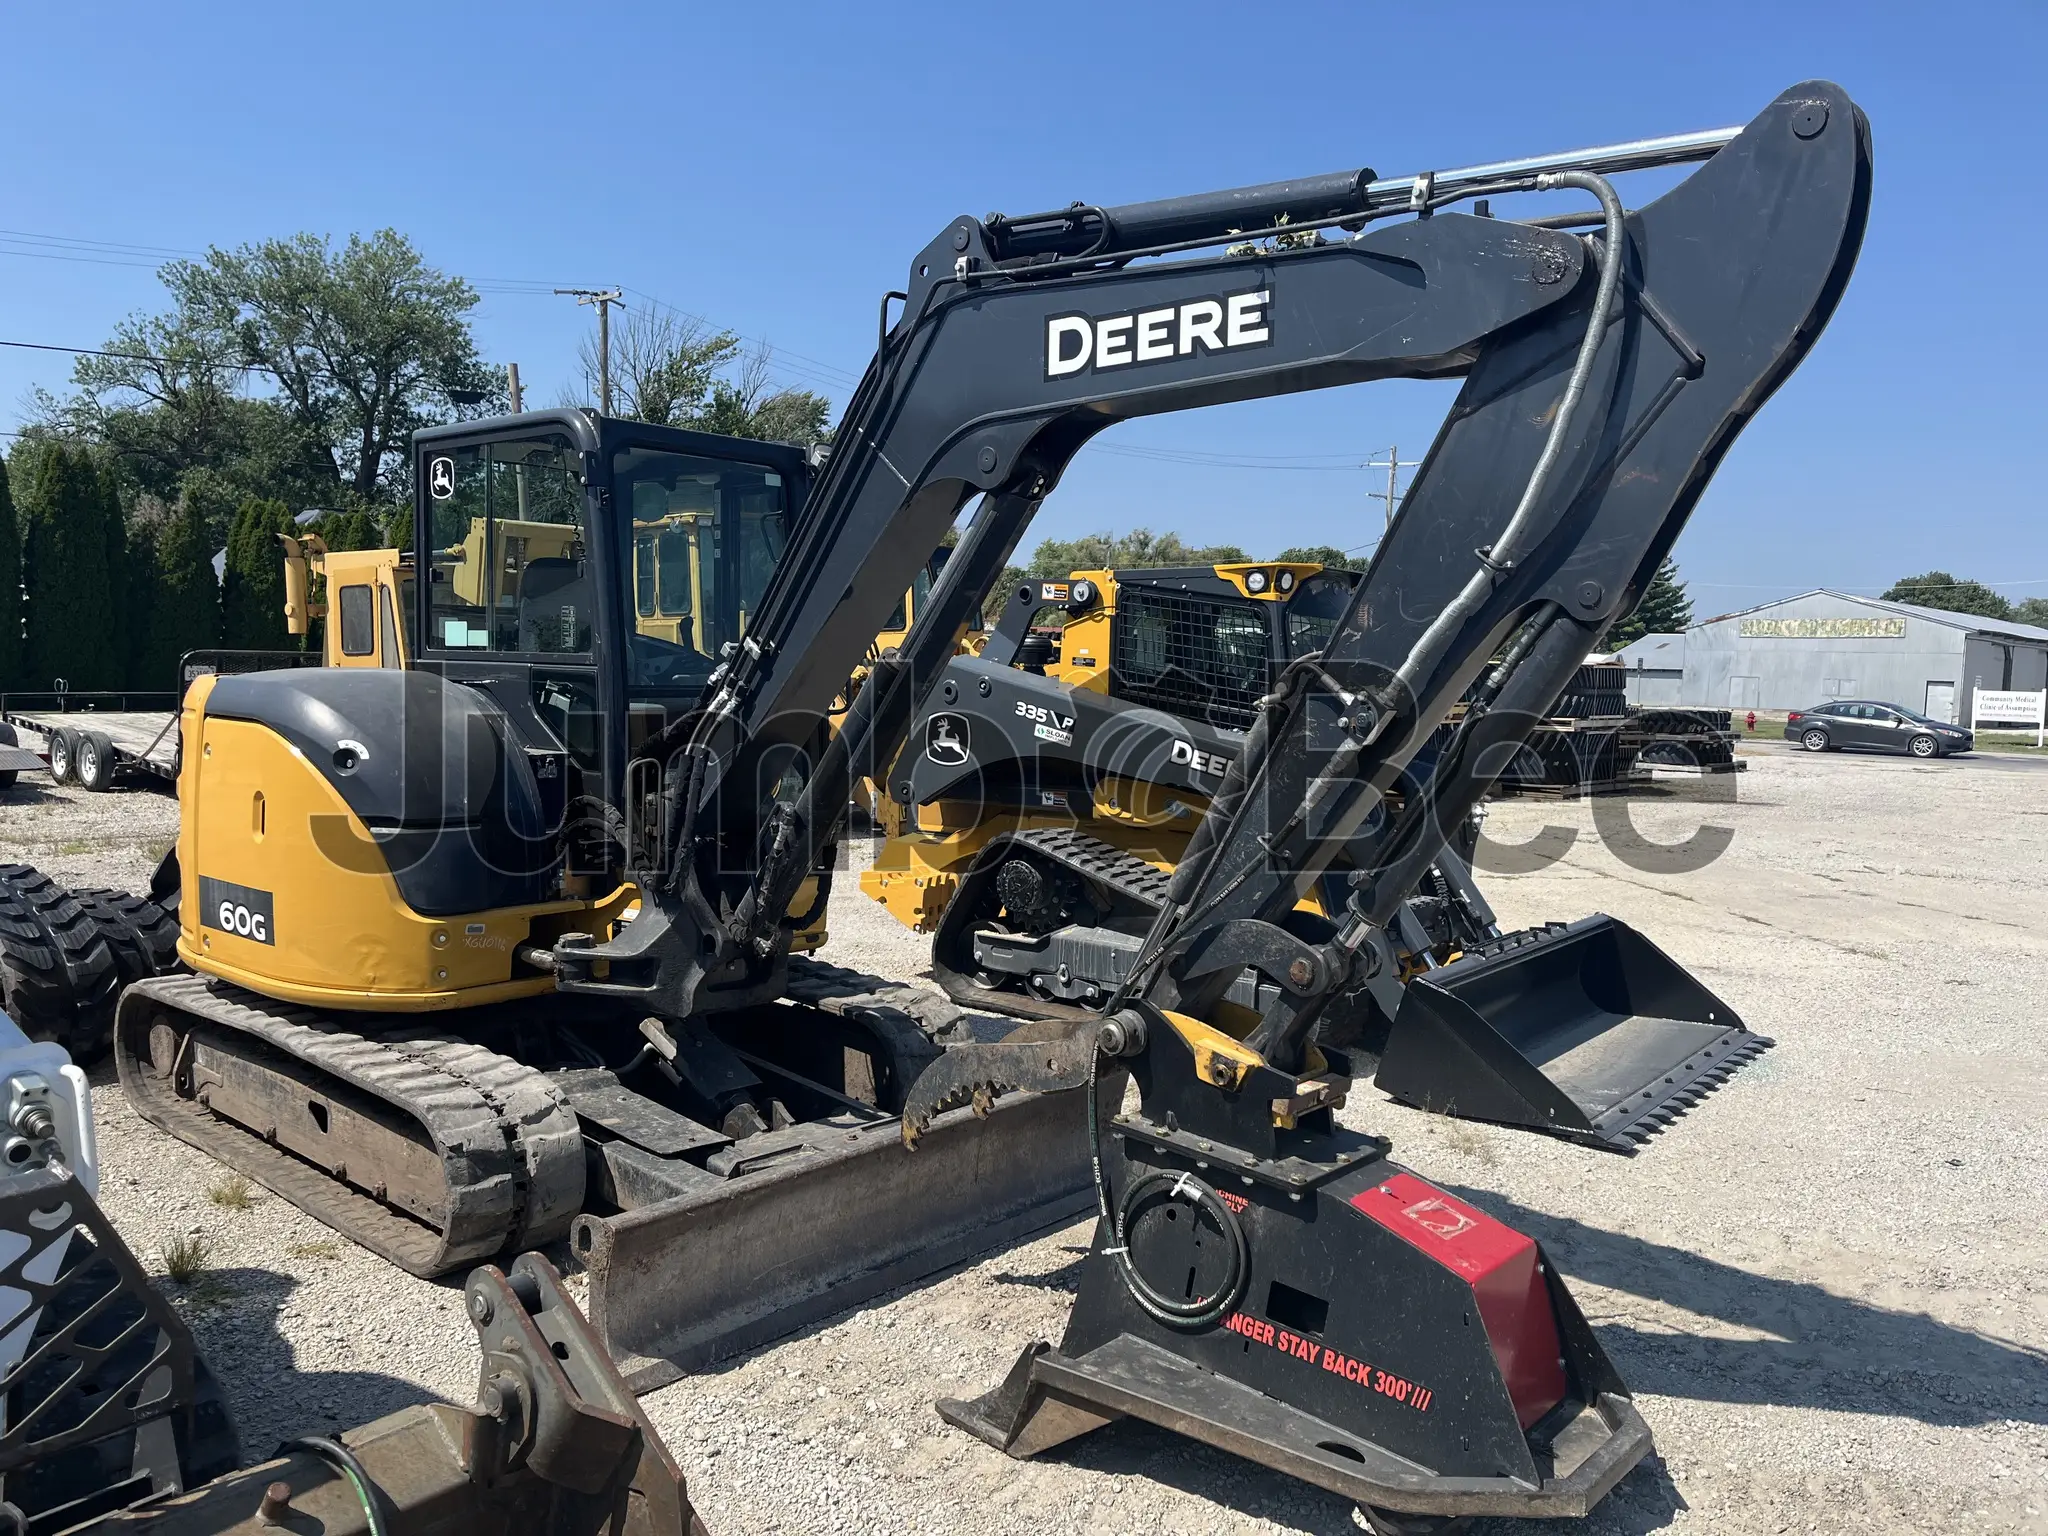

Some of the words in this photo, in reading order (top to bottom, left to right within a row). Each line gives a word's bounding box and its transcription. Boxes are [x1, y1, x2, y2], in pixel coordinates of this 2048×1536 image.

[1048, 290, 1270, 376] DEERE
[1015, 701, 1048, 723] 335
[1980, 703, 1997, 711] Clinic
[2005, 704, 2037, 713] Assumption
[1982, 695, 2013, 704] Community
[1046, 729, 1071, 741] SLOAN
[1170, 739, 1234, 778] DEE
[219, 901, 266, 941] 60G
[1093, 1156, 1101, 1183] EC215-08
[1278, 1331, 1320, 1364] STAY
[1322, 1349, 1372, 1387] BACK
